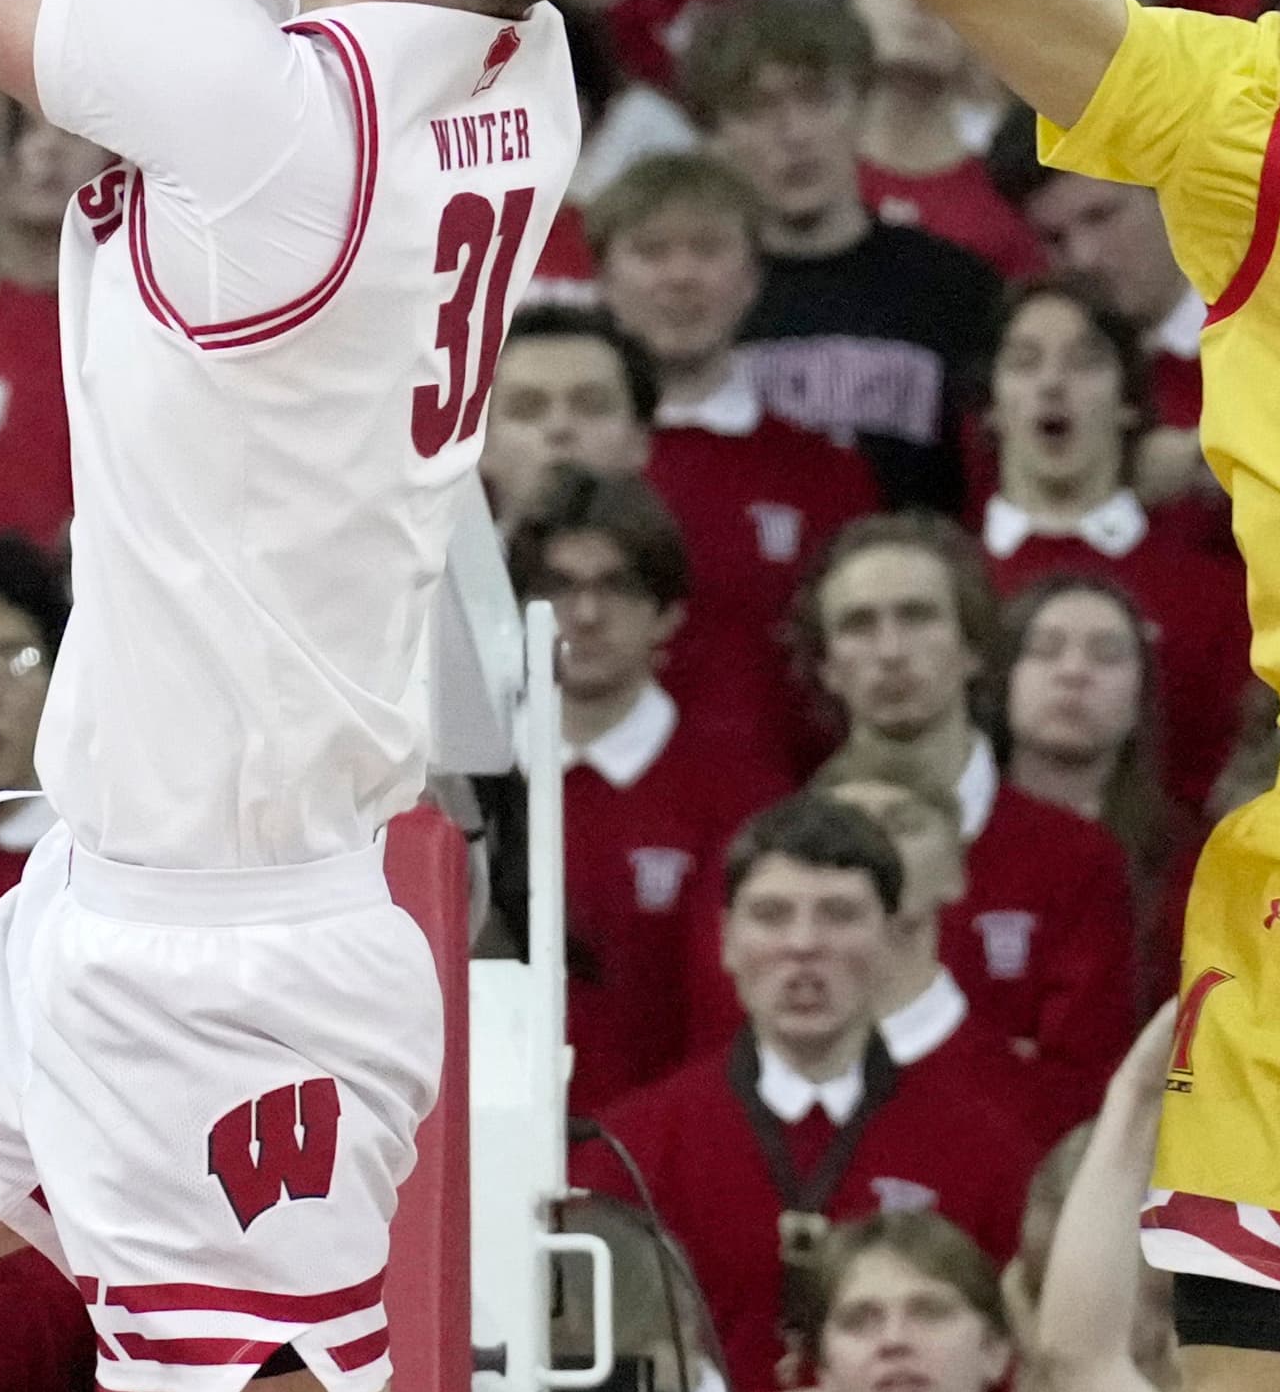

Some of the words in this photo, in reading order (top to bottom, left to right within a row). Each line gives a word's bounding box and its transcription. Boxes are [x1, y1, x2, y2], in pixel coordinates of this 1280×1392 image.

[431, 107, 531, 172] WINTER
[411, 186, 537, 460] 31
[207, 1077, 342, 1234] W
